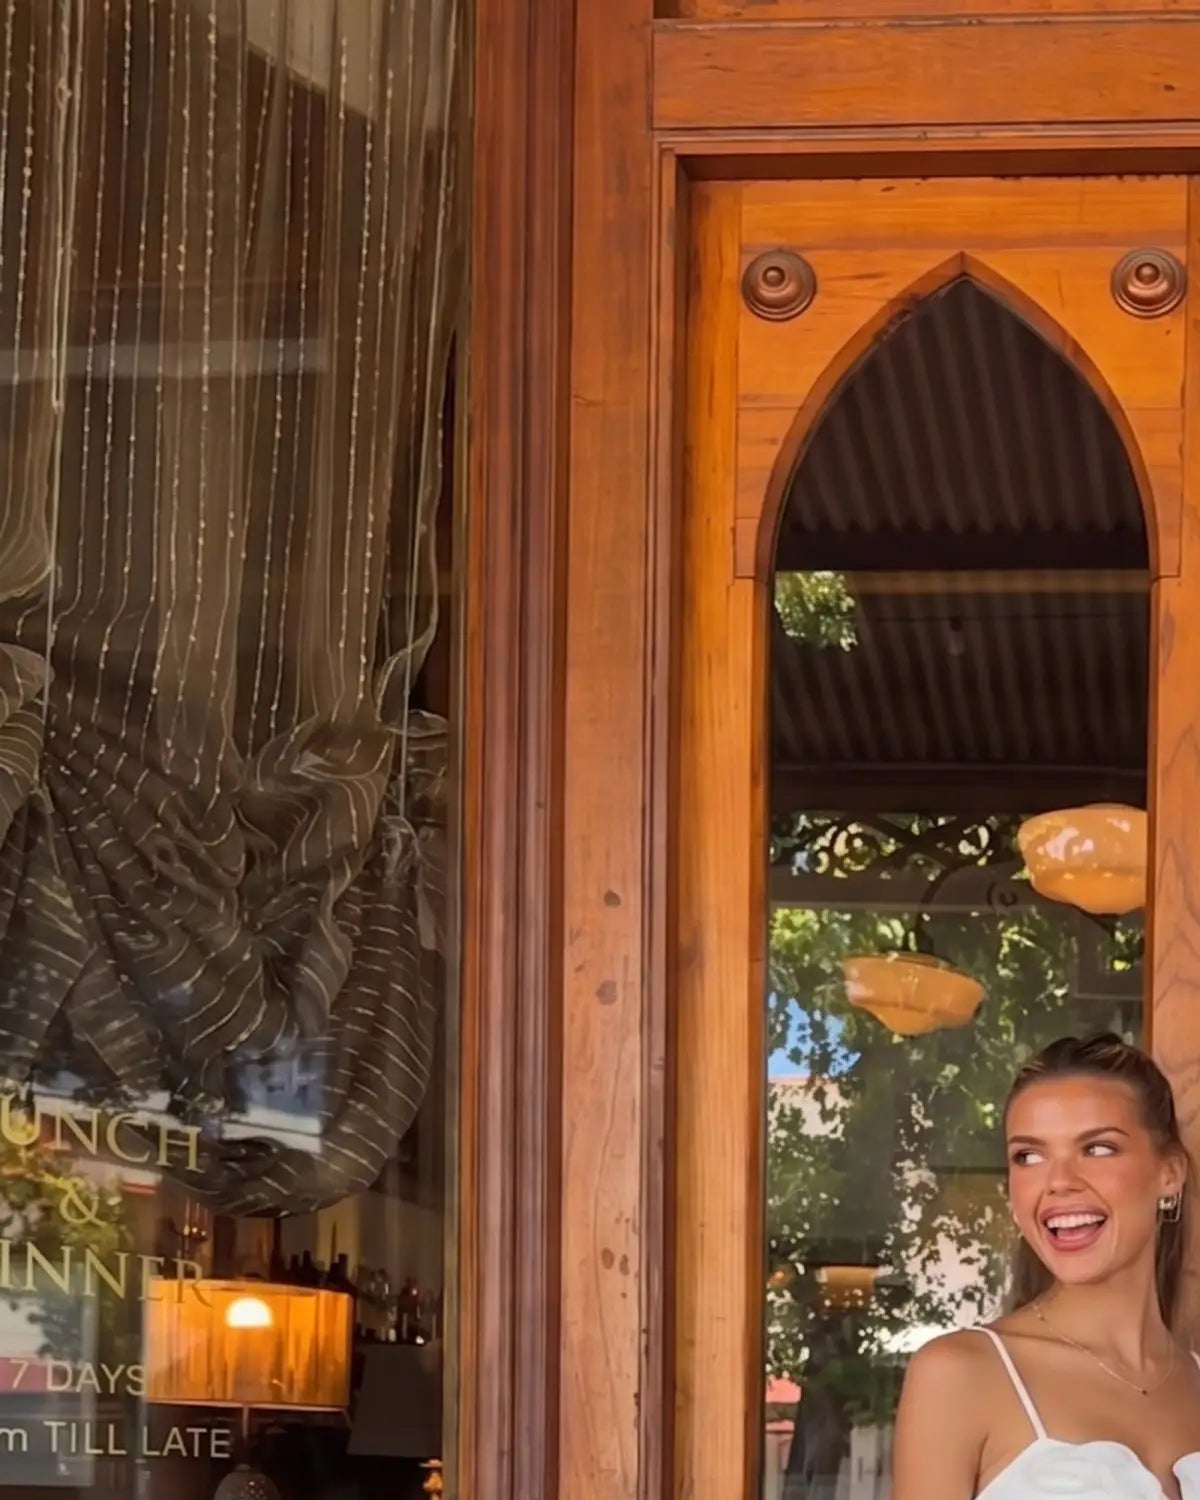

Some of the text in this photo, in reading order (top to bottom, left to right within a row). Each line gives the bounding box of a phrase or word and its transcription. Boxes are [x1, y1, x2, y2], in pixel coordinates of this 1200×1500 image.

[0, 1093, 205, 1174] UNCH
[59, 1175, 107, 1227] &
[0, 1237, 213, 1308] INNER
[9, 1358, 146, 1396] 7 DAYS
[43, 1420, 127, 1455] TILL
[142, 1426, 231, 1458] LATE
